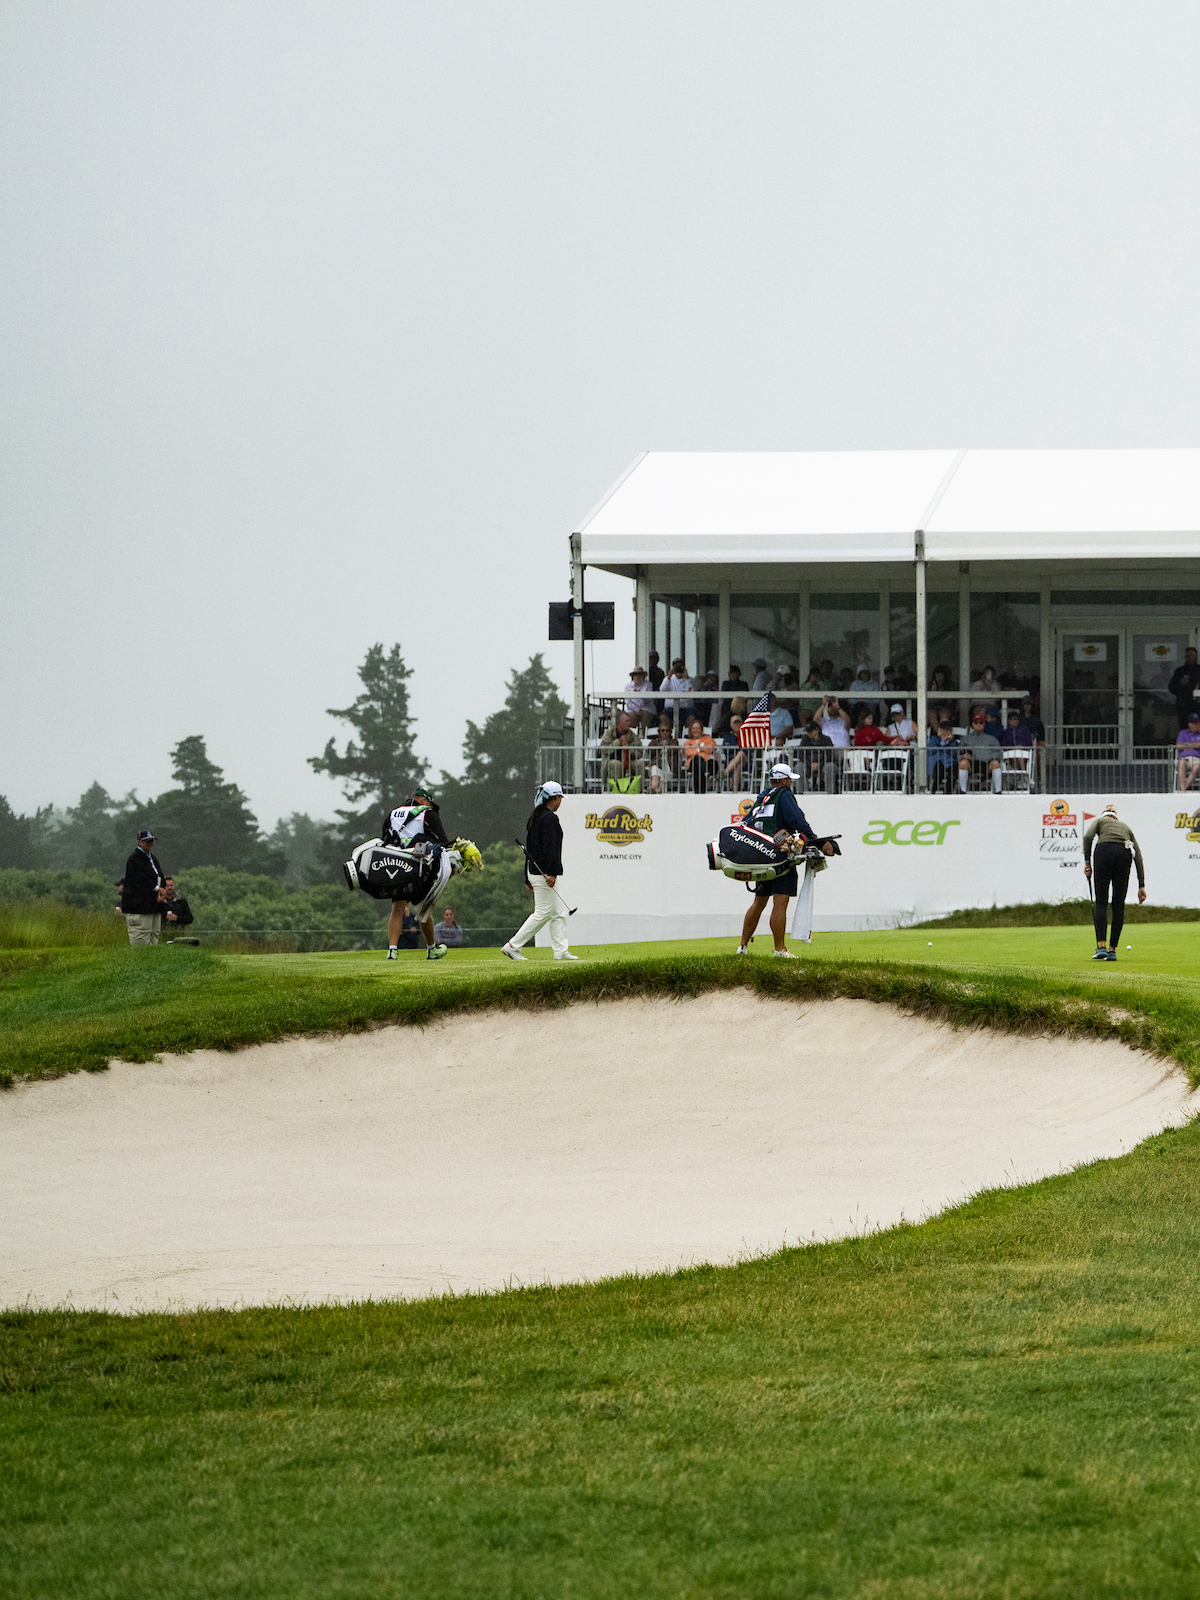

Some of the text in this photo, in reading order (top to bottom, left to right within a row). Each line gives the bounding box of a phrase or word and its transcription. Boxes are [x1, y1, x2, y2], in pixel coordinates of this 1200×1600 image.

[585, 813, 653, 832] Hard Rock
[862, 819, 961, 846] acer
[1041, 828, 1079, 839] LPGA
[729, 829, 777, 860] TaylorMade
[1039, 839, 1081, 853] Classic
[371, 856, 413, 873] Callaway
